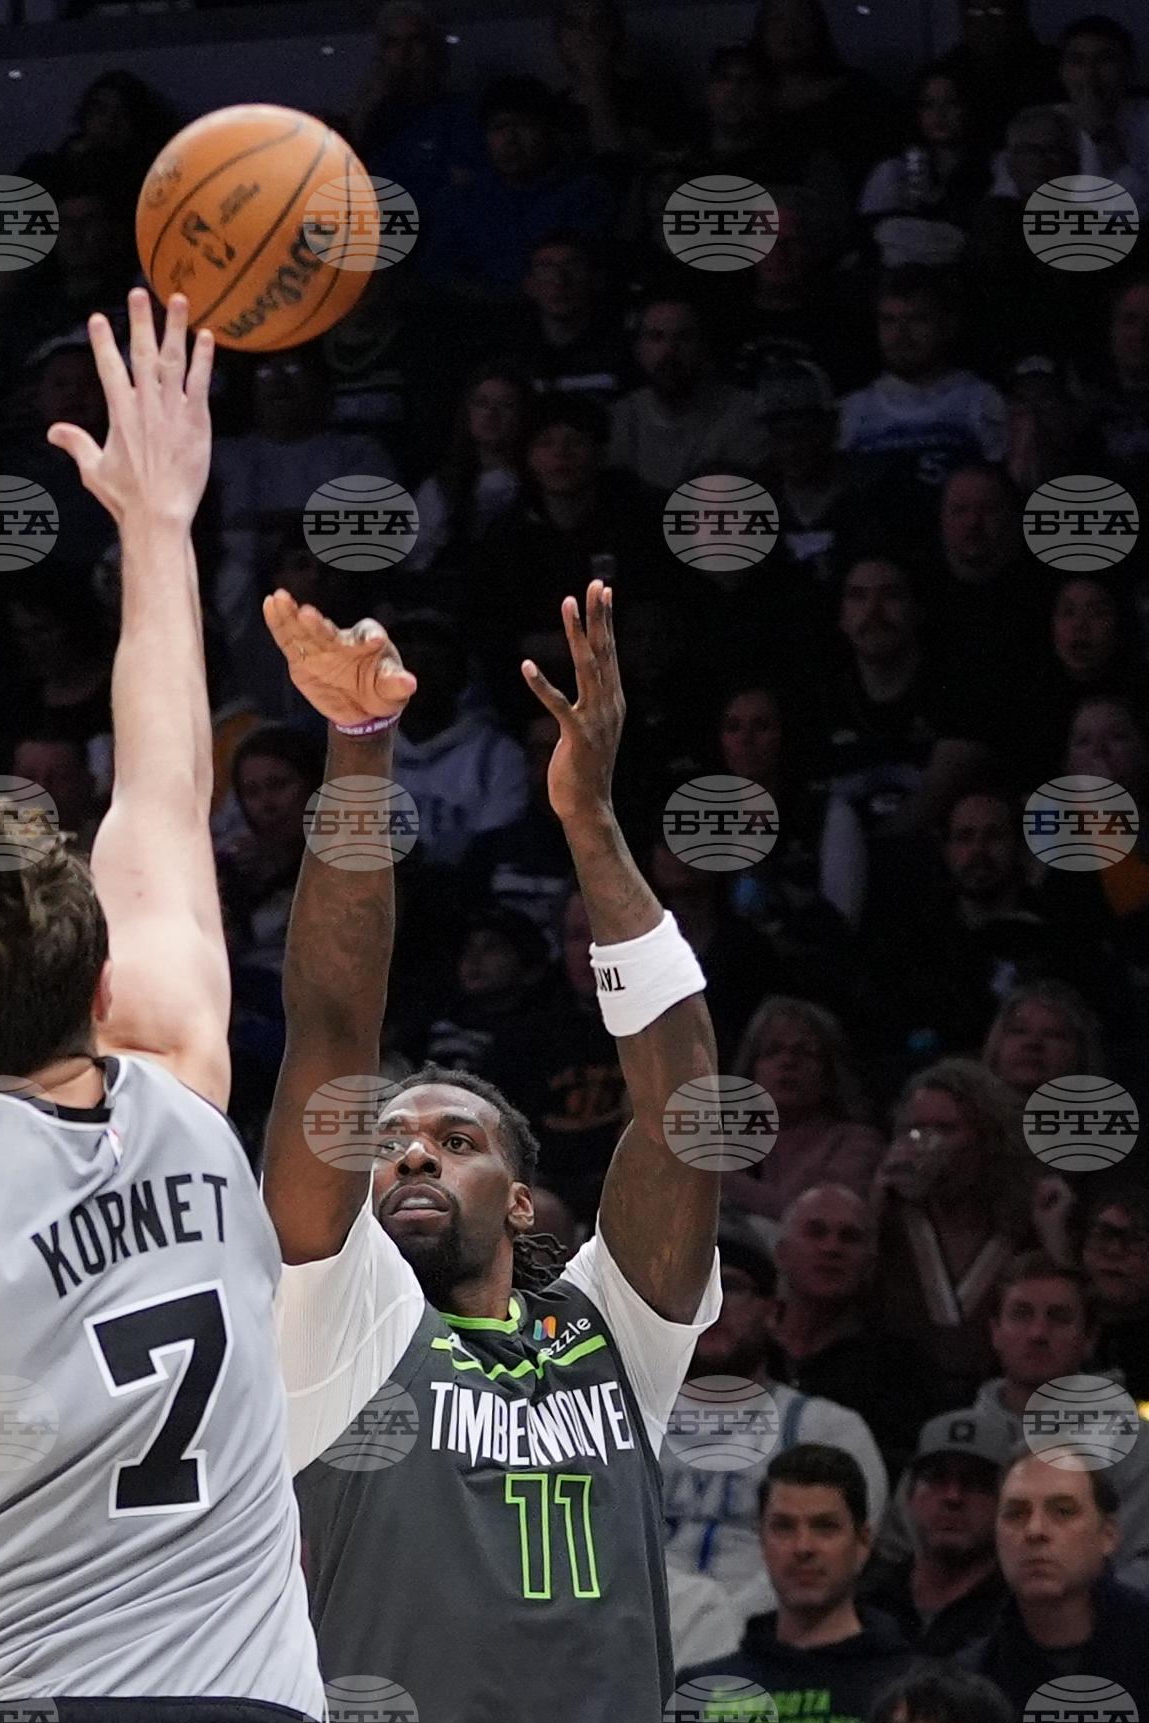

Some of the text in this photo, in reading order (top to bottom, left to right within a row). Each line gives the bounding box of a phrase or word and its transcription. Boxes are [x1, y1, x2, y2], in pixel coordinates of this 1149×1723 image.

[31, 1173, 227, 1298] KORNET
[83, 1279, 234, 1519] 7
[539, 1318, 591, 1356] ezzle
[430, 1381, 634, 1467] TIMBERWOLVE
[505, 1473, 601, 1599] 11
